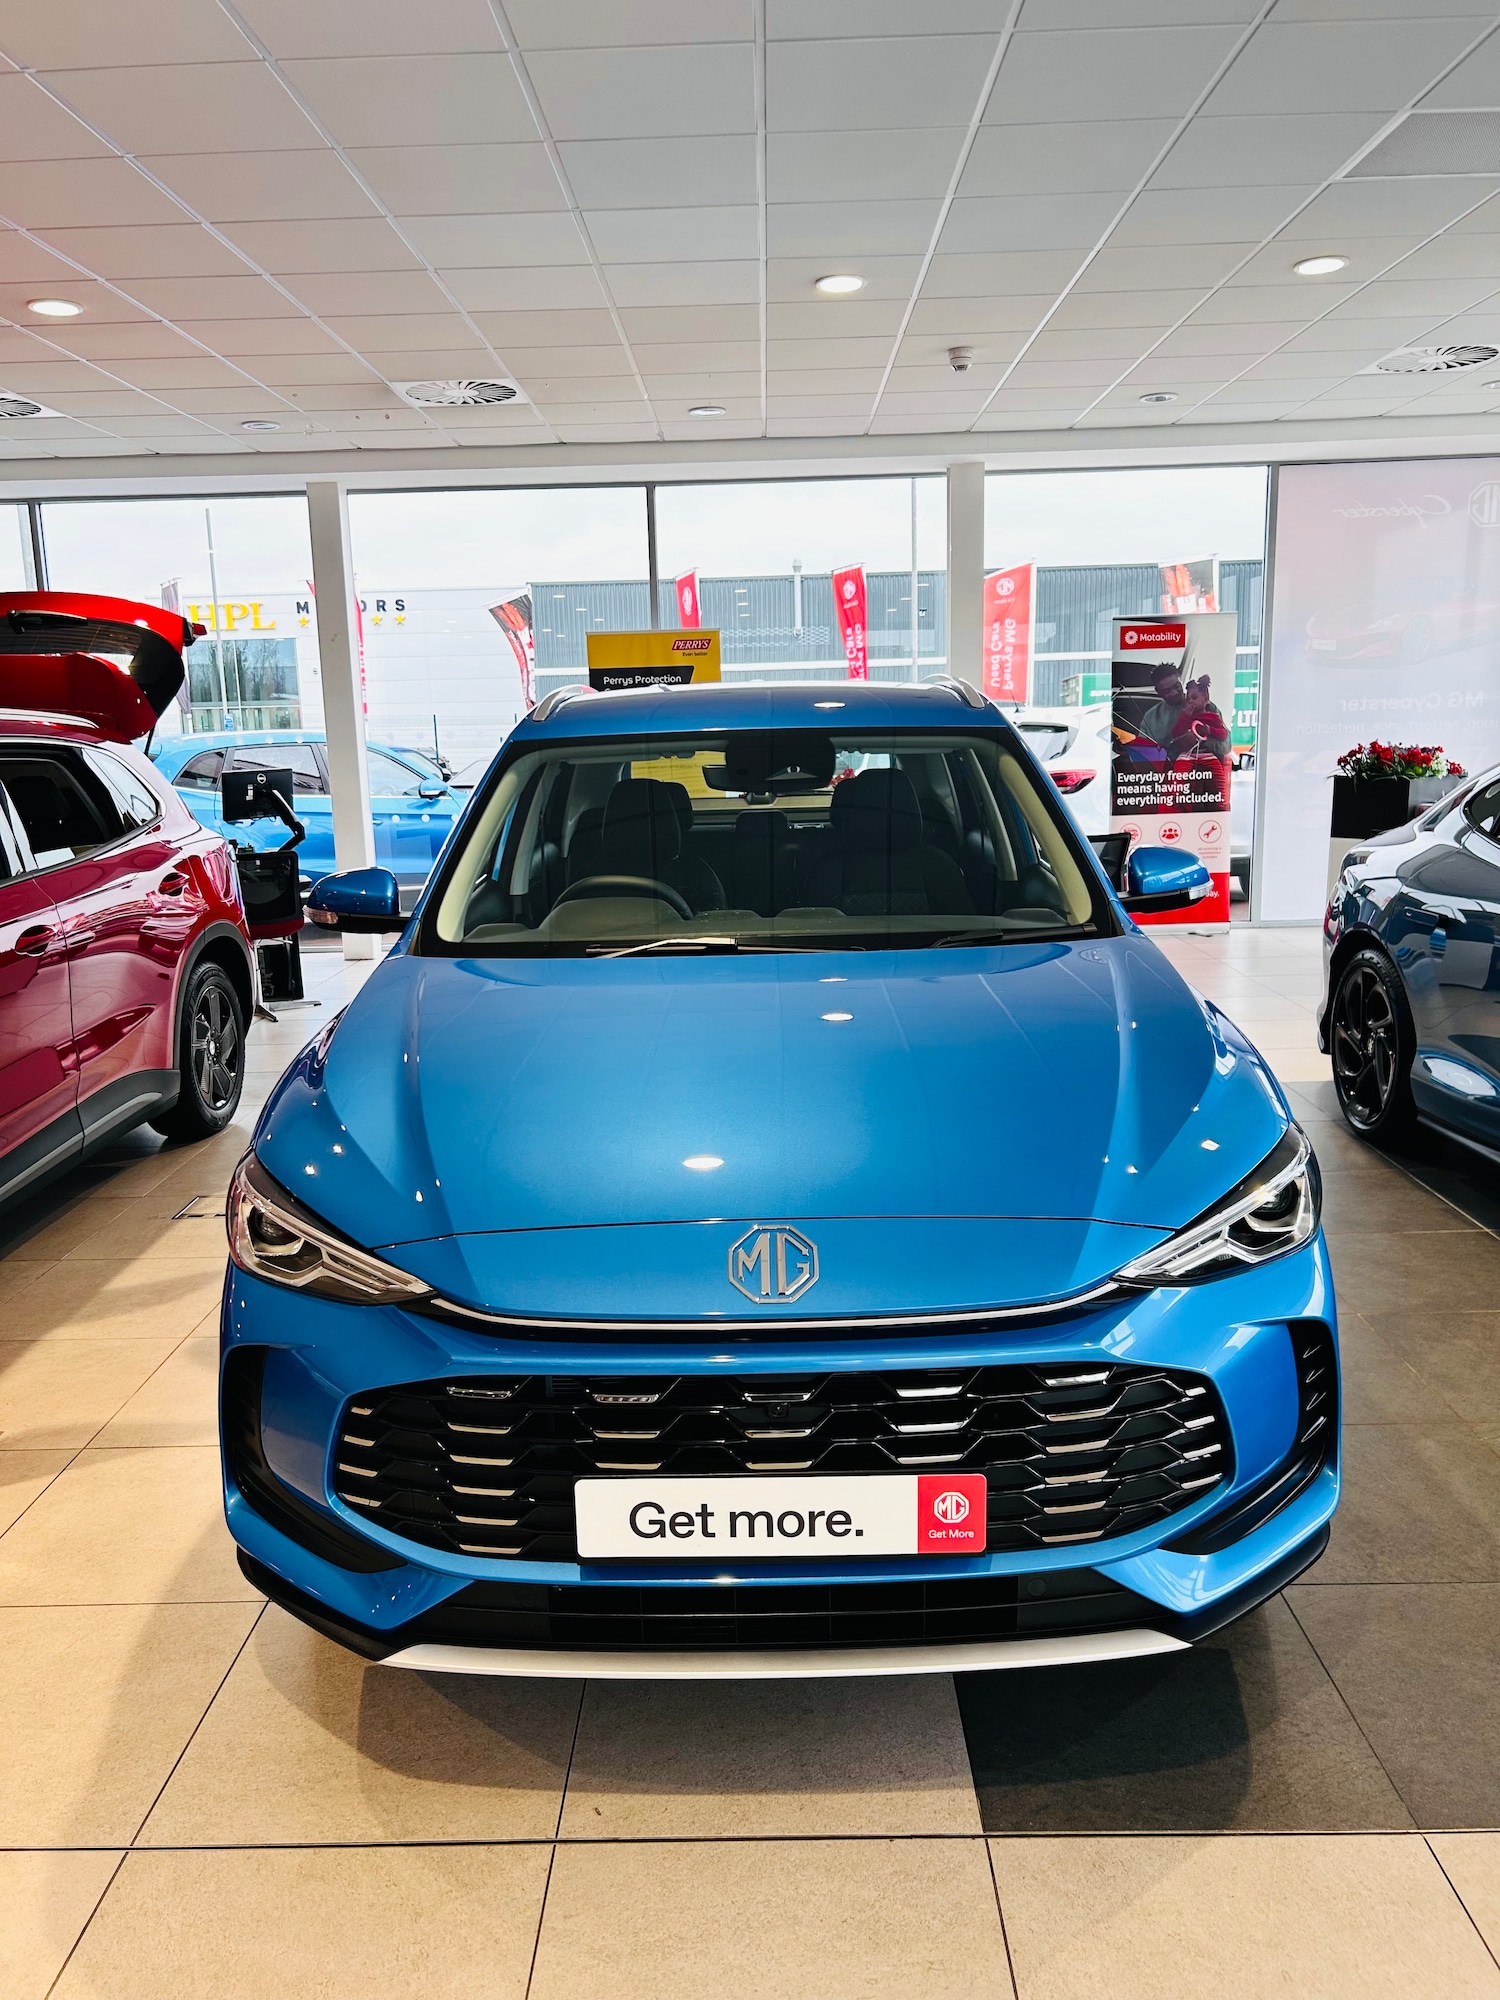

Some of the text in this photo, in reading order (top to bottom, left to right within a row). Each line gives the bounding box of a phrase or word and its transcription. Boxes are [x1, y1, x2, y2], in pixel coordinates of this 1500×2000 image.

[187, 598, 406, 632] HPL MORS
[1139, 631, 1182, 643] Motability
[673, 639, 710, 650] PERRYS
[603, 674, 682, 687] Perrys Protection
[1117, 770, 1213, 784] Everyday freedom
[1117, 782, 1190, 795] means having
[1117, 792, 1225, 807] everything included.
[733, 1228, 814, 1300] MG
[937, 1494, 967, 1521] MG
[629, 1501, 864, 1540] Get more.
[928, 1529, 974, 1539] Get More
